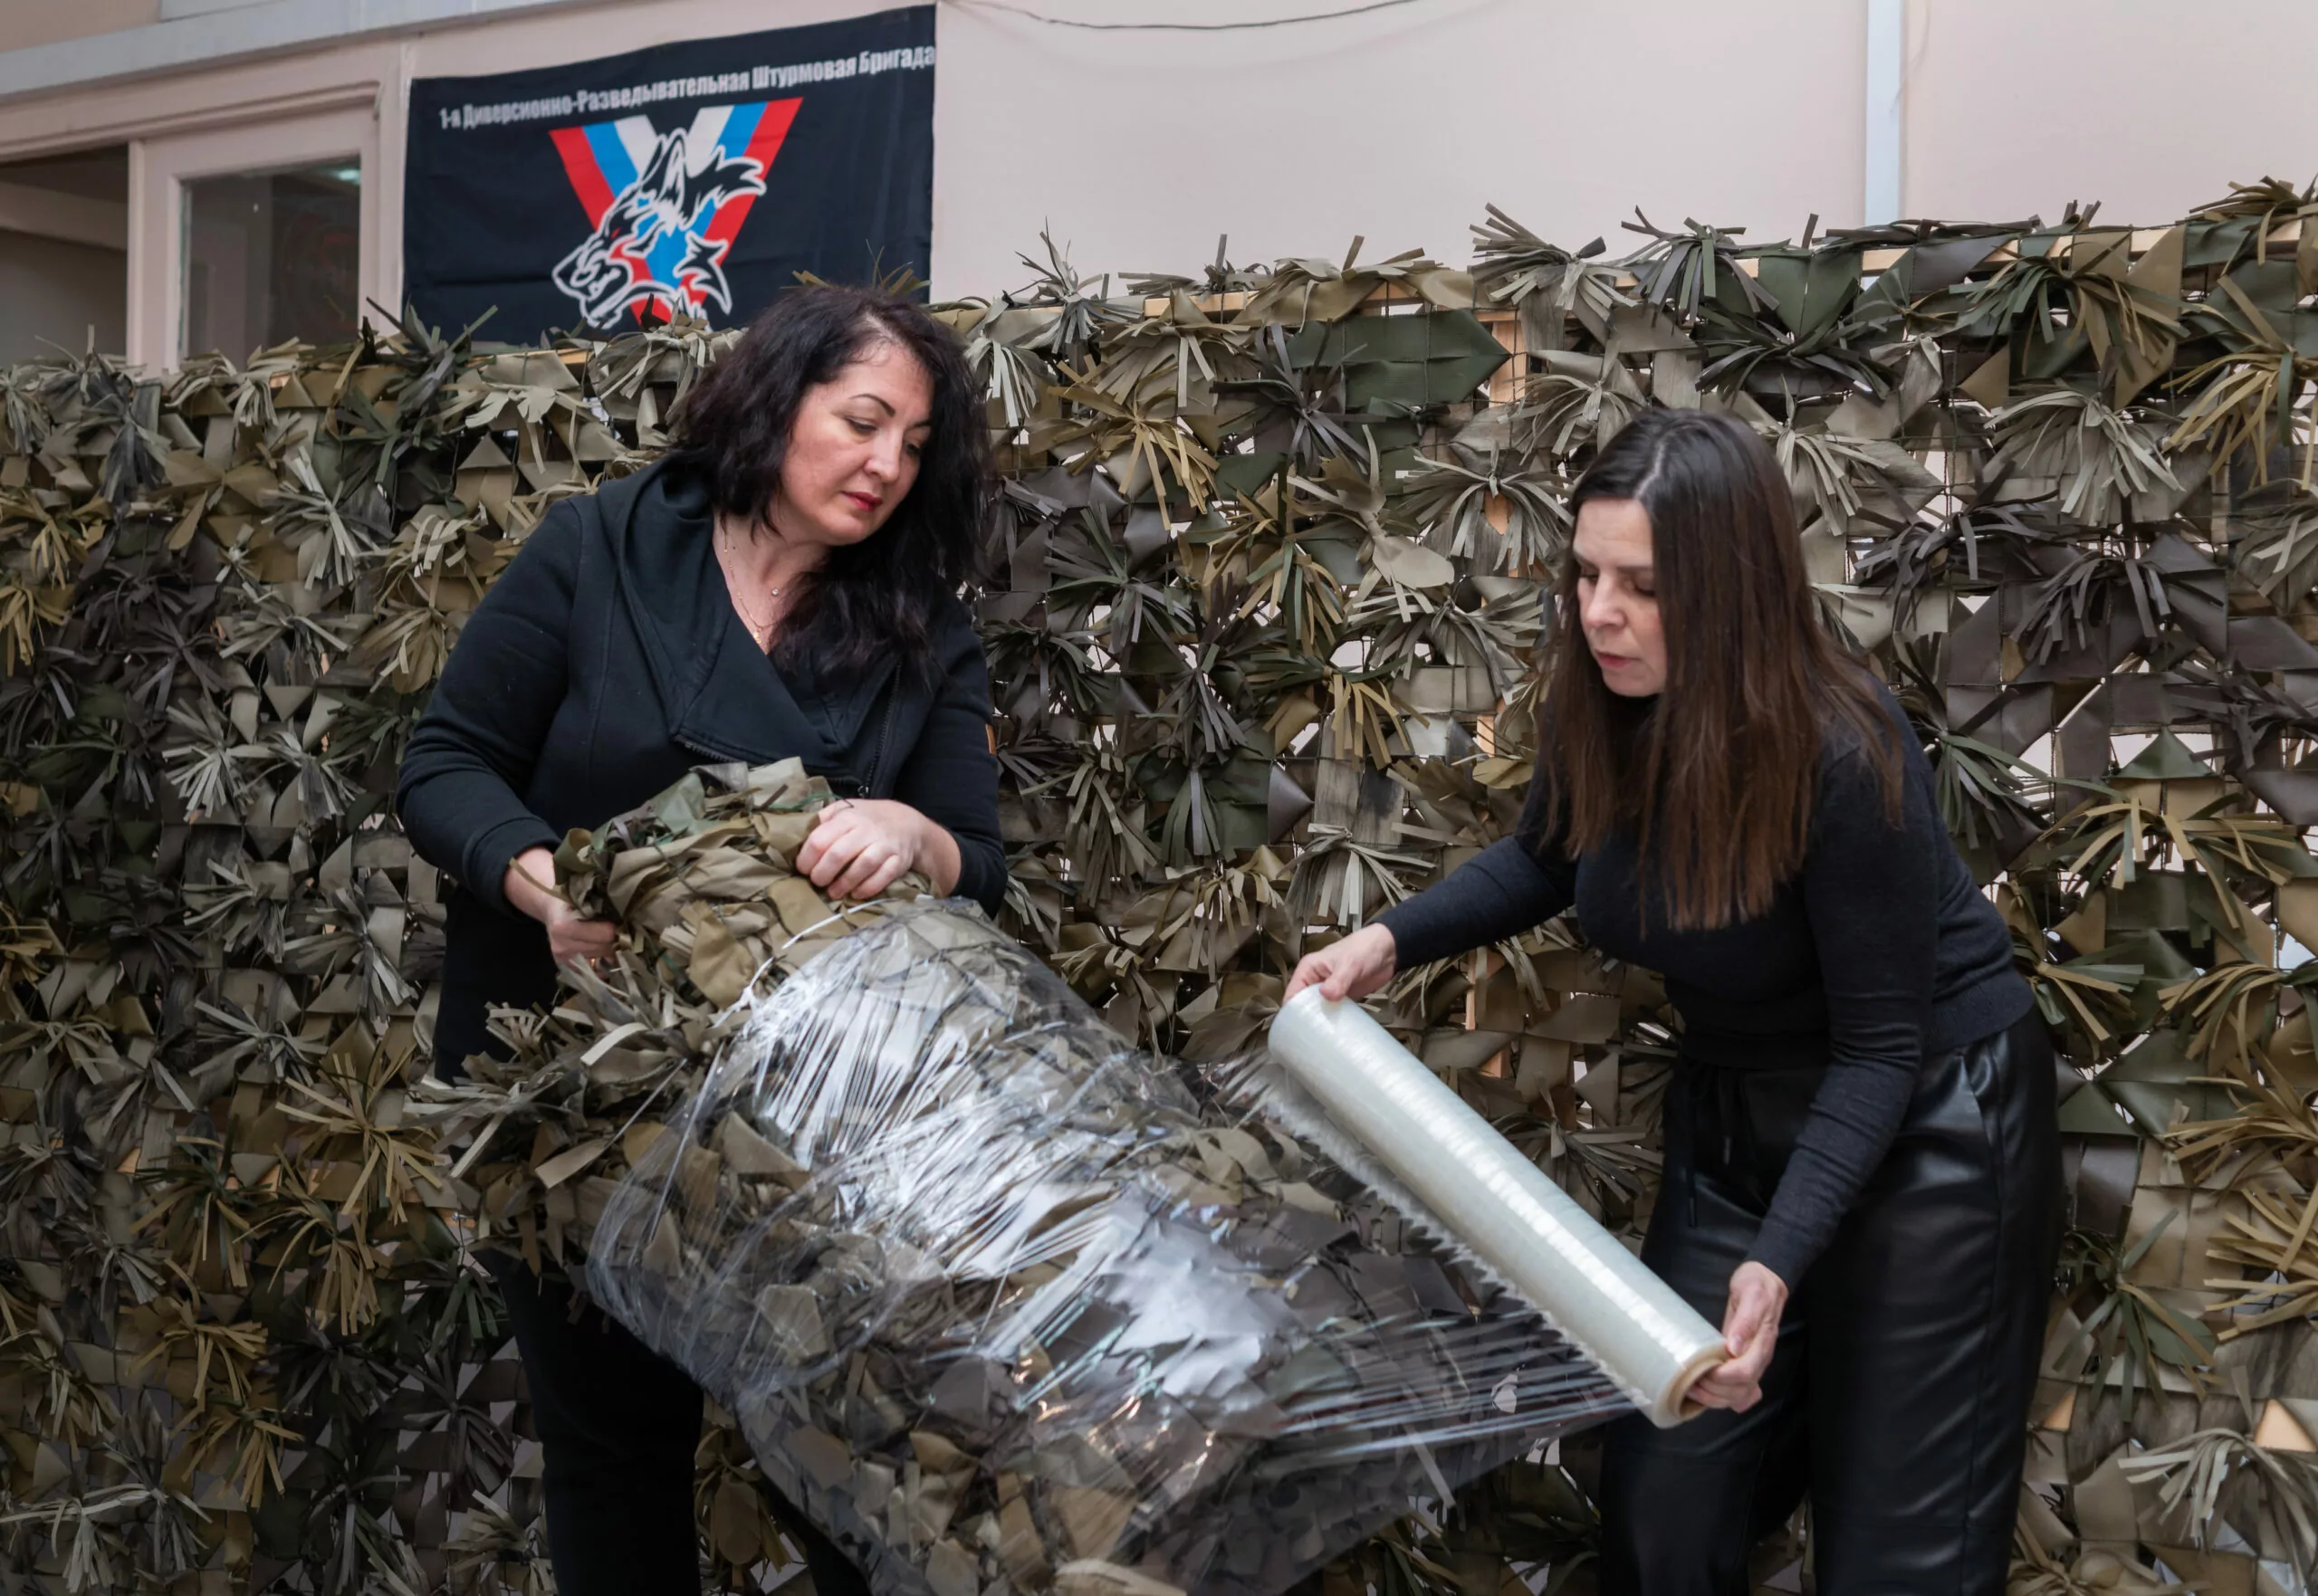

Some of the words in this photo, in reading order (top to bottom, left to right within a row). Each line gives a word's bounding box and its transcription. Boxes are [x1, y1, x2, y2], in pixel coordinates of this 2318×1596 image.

[440, 108, 461, 129] 1-я
[463, 72, 750, 129] Диверсионно-Разведывательная
[752, 57, 857, 90] Штурмовая
[858, 45, 936, 74] Бригада
